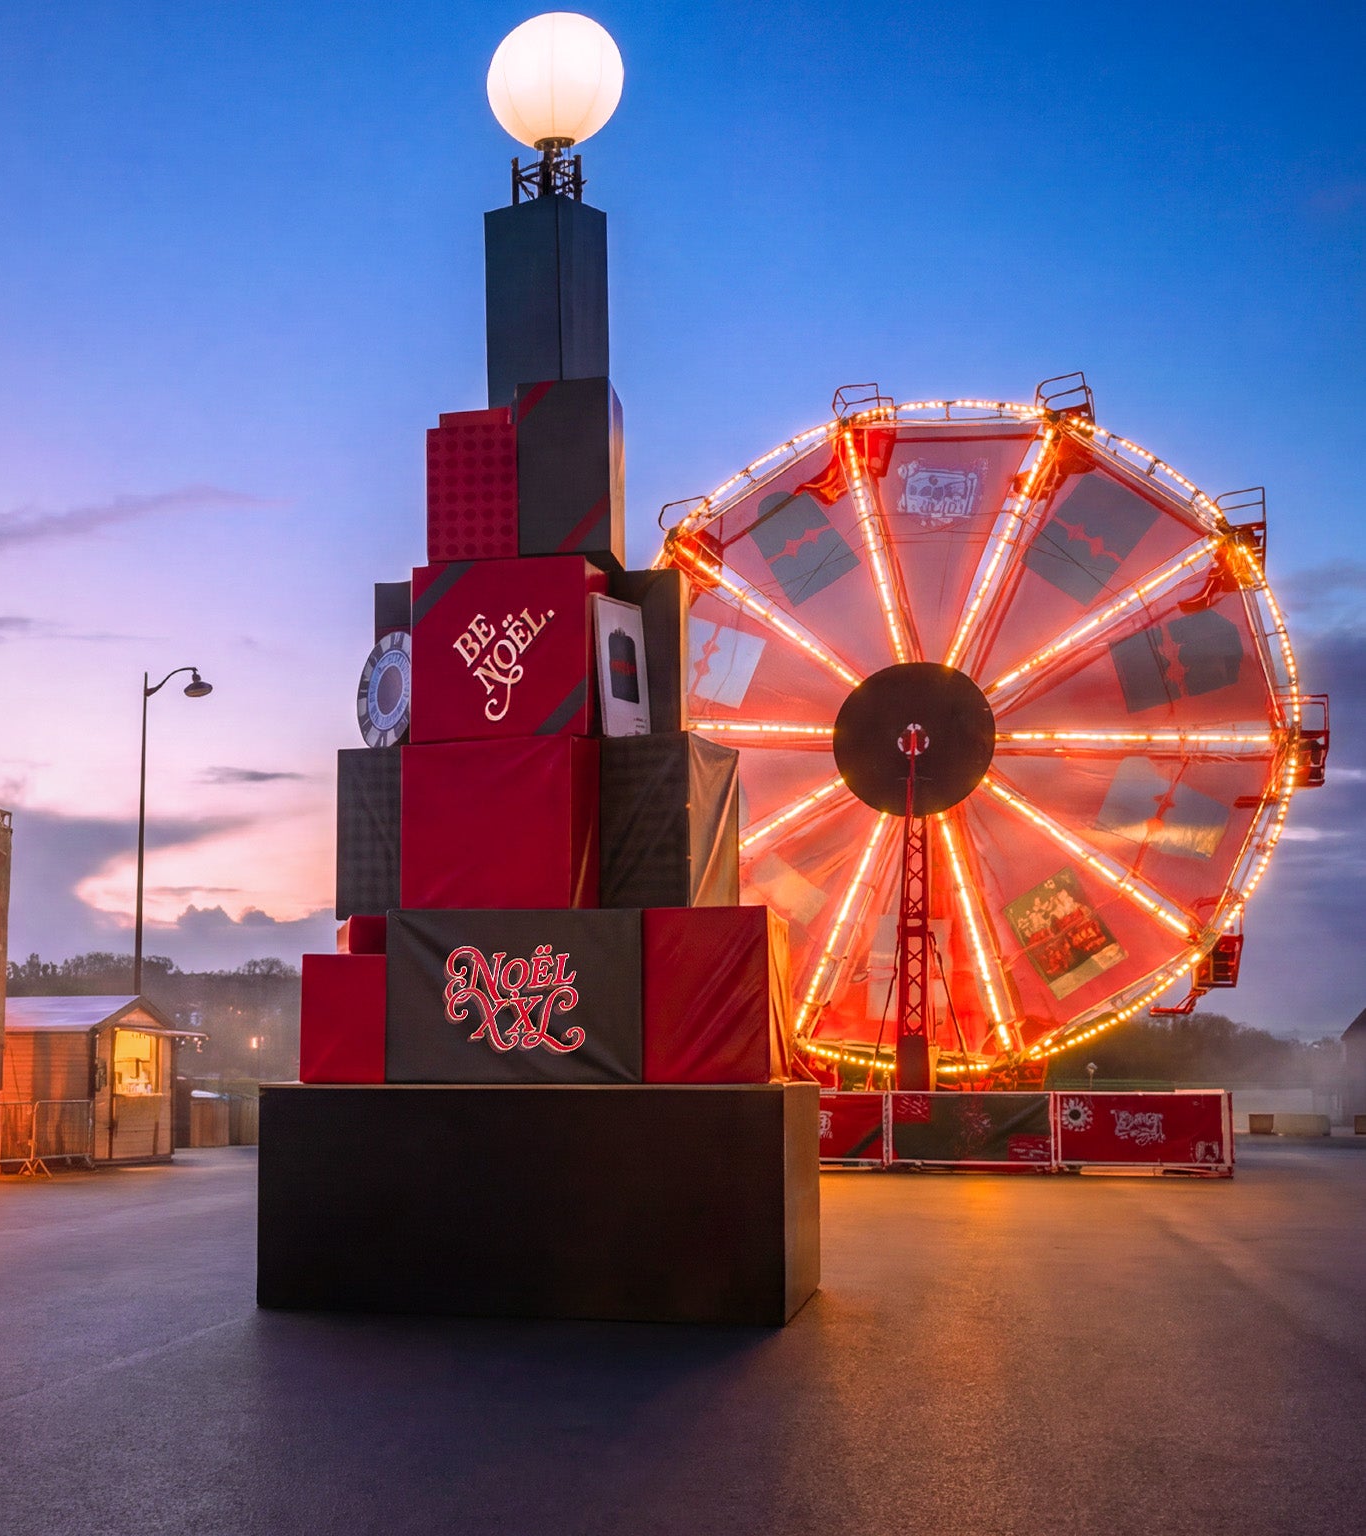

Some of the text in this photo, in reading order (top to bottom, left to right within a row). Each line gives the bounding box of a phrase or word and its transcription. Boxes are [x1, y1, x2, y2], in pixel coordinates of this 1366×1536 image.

[453, 614, 496, 667] BE
[473, 608, 555, 721] NOËL.
[443, 944, 577, 1004] NOËL
[445, 986, 585, 1054] XXL
